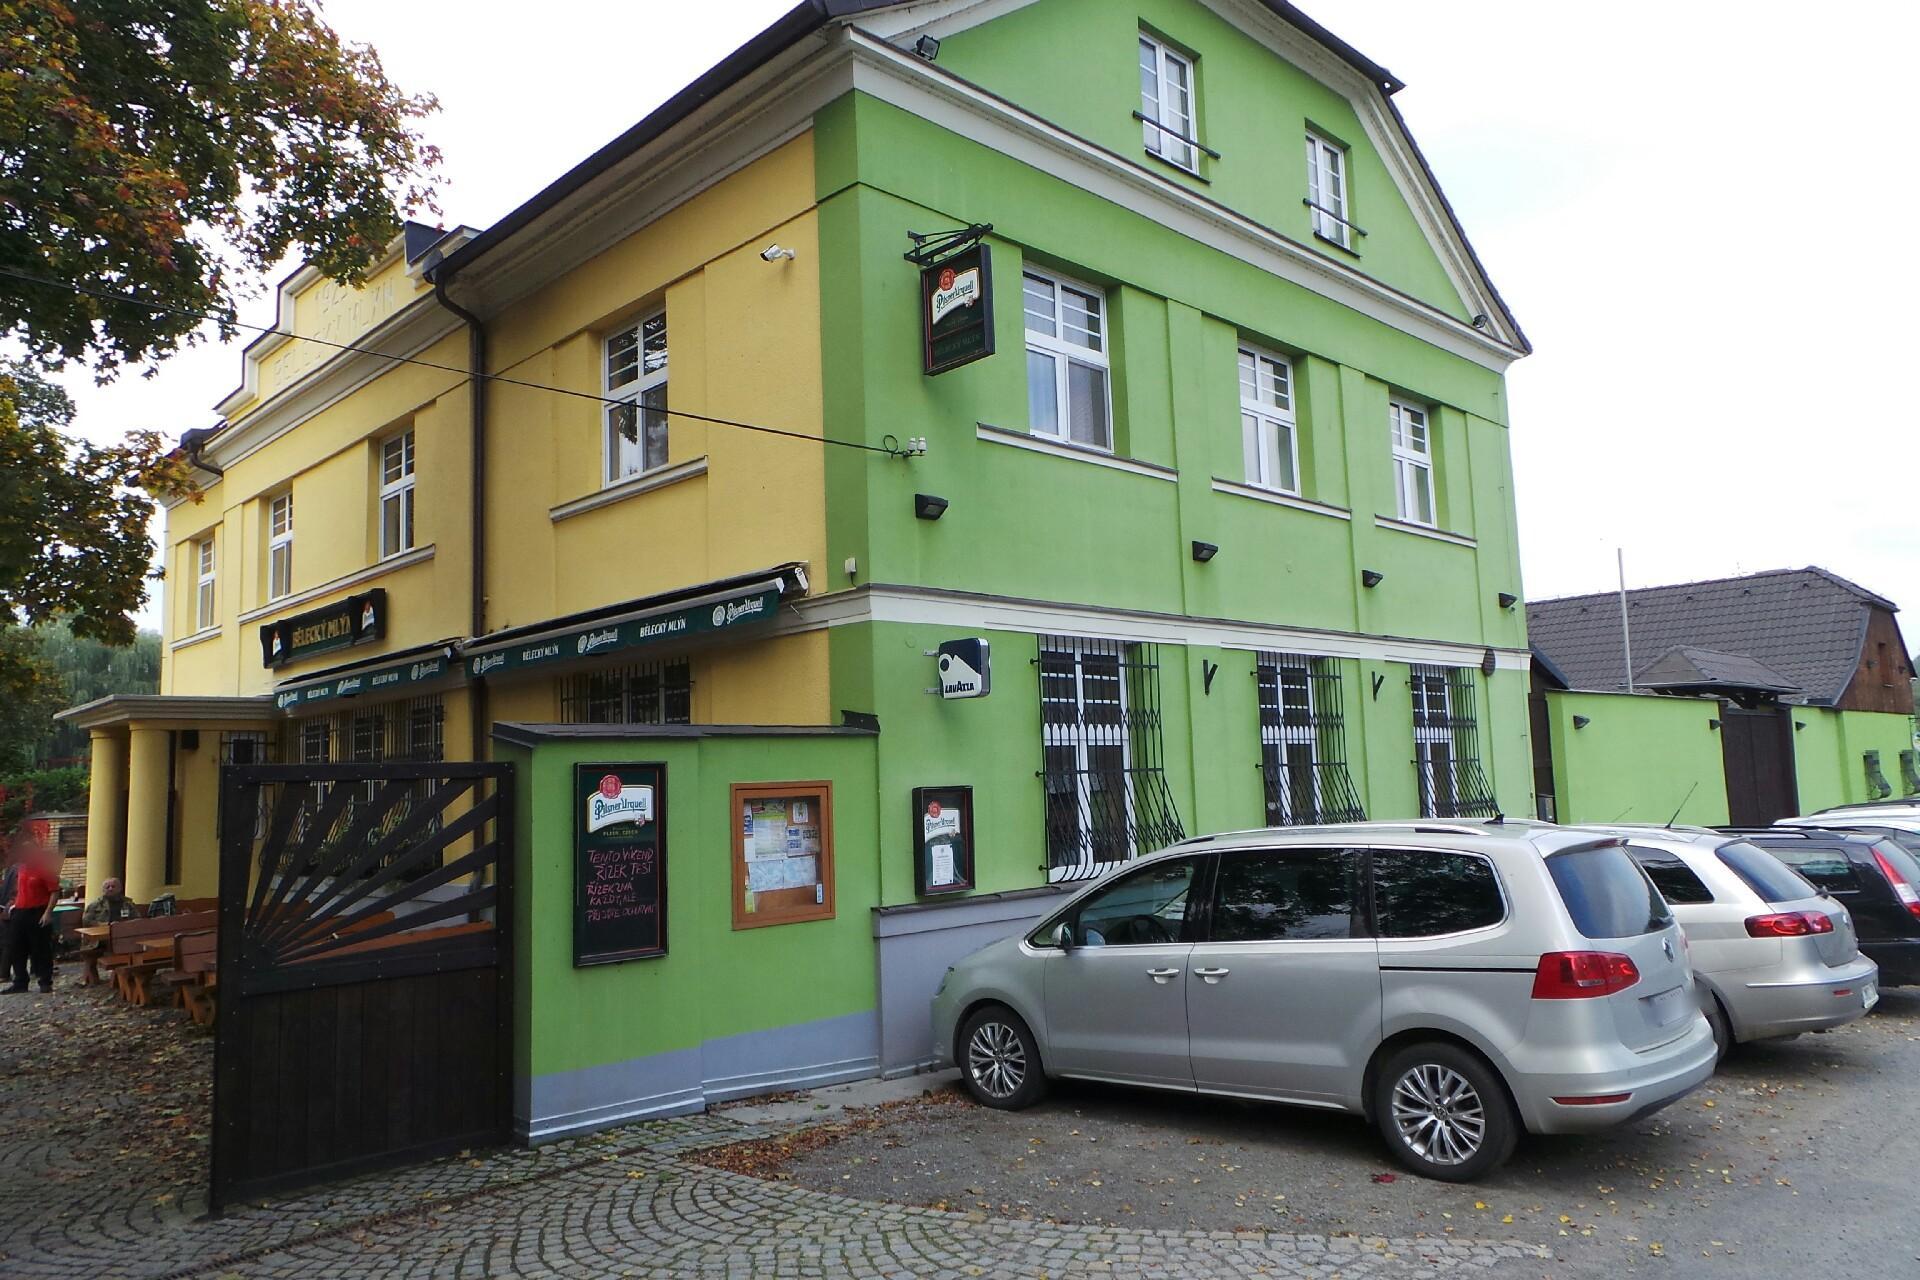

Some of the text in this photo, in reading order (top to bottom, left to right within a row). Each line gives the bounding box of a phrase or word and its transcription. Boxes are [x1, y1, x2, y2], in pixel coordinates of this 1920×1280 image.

[292, 619, 327, 649] BĚLECKÝ
[640, 616, 686, 638] BĚLECKÝ MLÝN
[944, 680, 975, 694] LAVAZZA
[594, 798, 647, 821] Pilsner Urquell
[587, 849, 621, 864] TENTO
